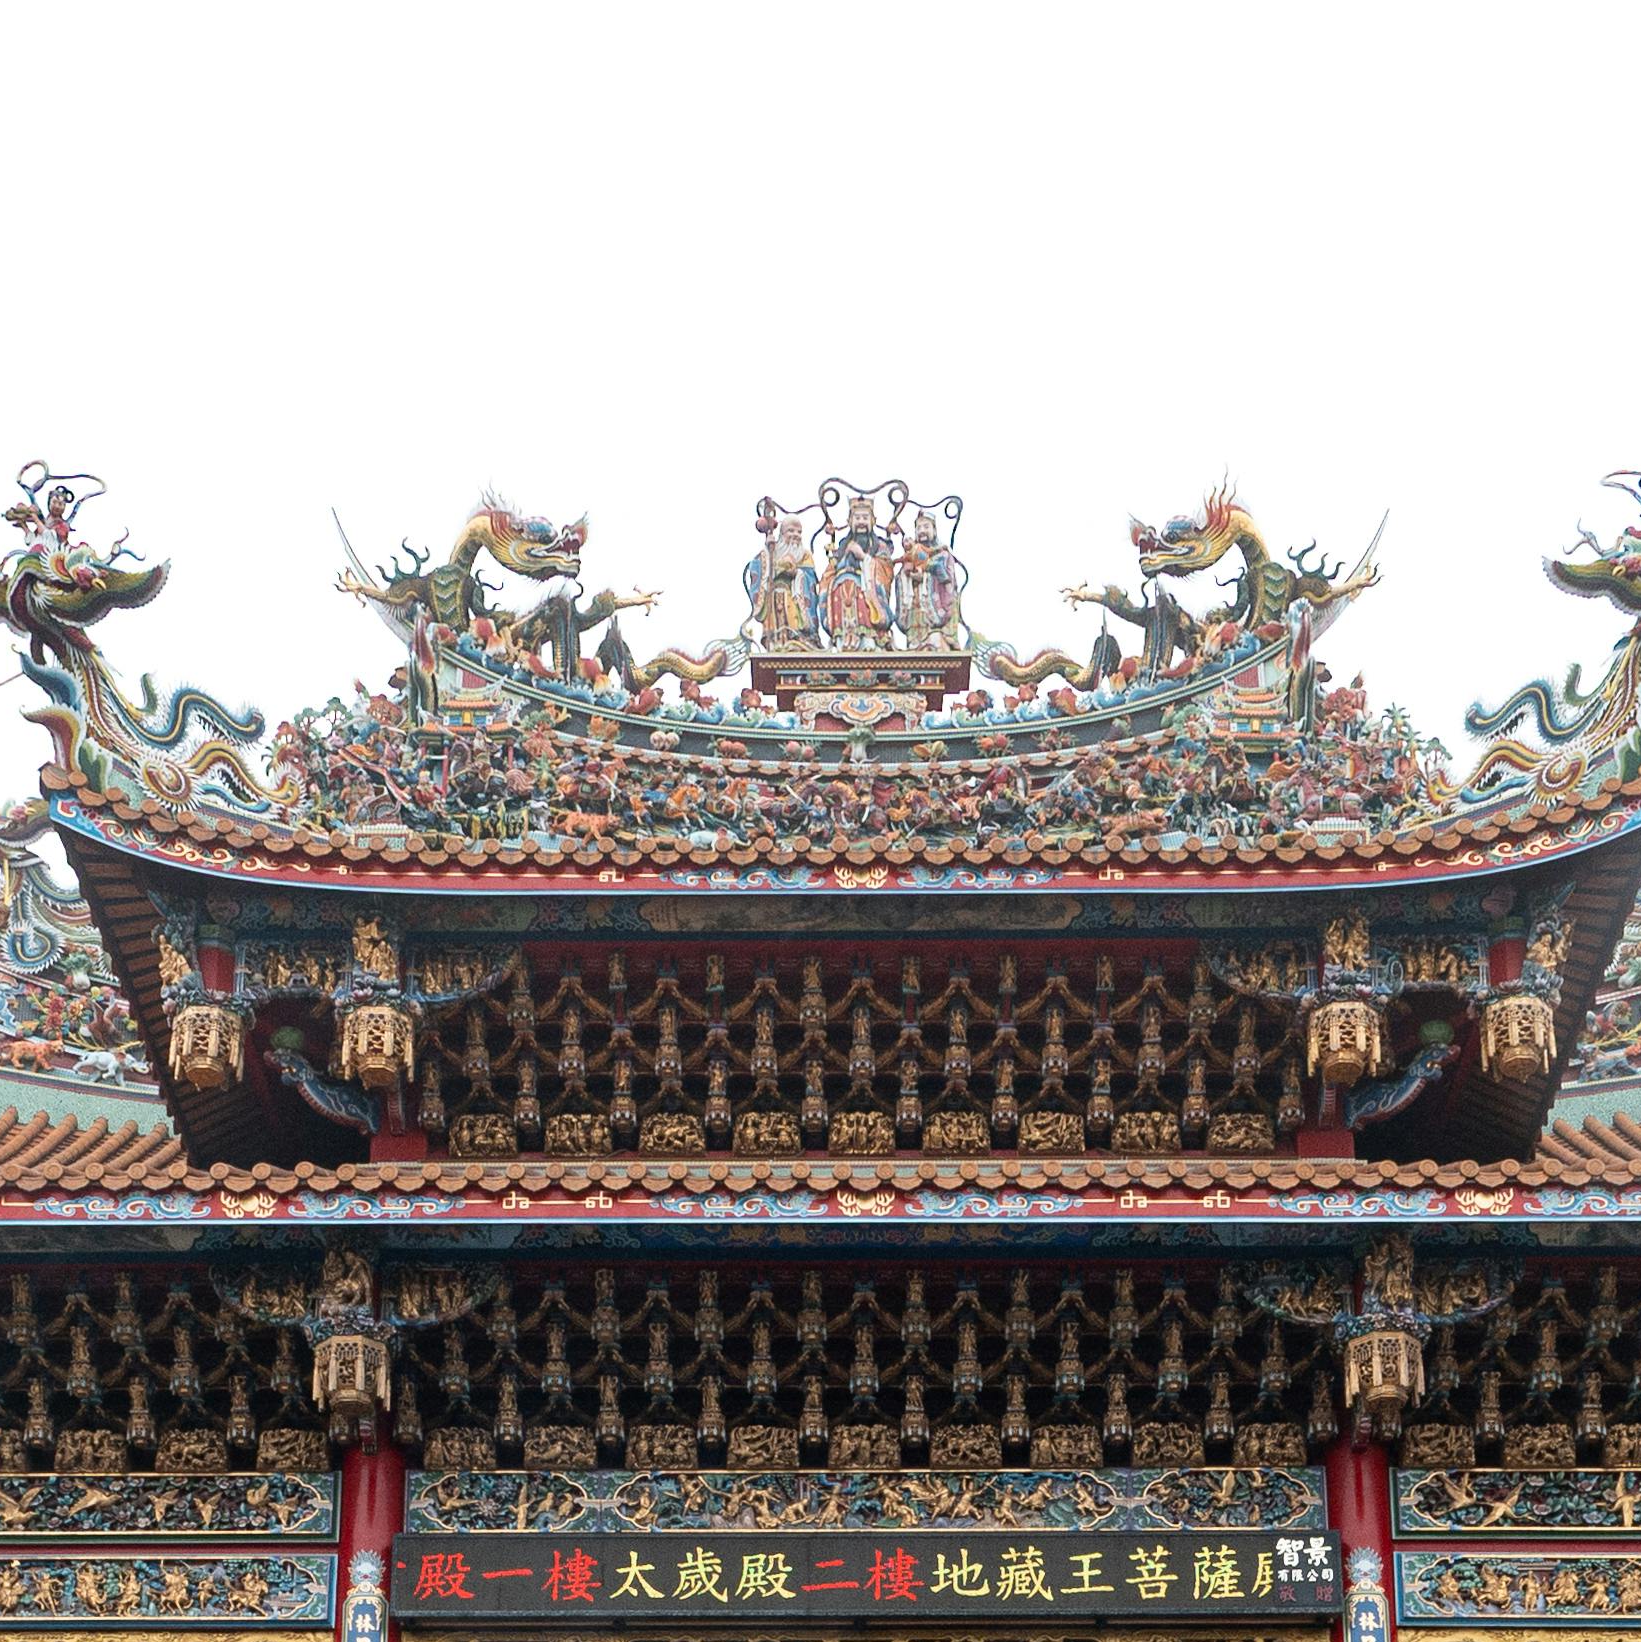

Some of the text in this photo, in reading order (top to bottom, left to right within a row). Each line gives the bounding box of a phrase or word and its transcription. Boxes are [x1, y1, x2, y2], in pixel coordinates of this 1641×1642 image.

[1275, 1537, 1333, 1567] 智景
[1277, 1568, 1334, 1583] 有限公司
